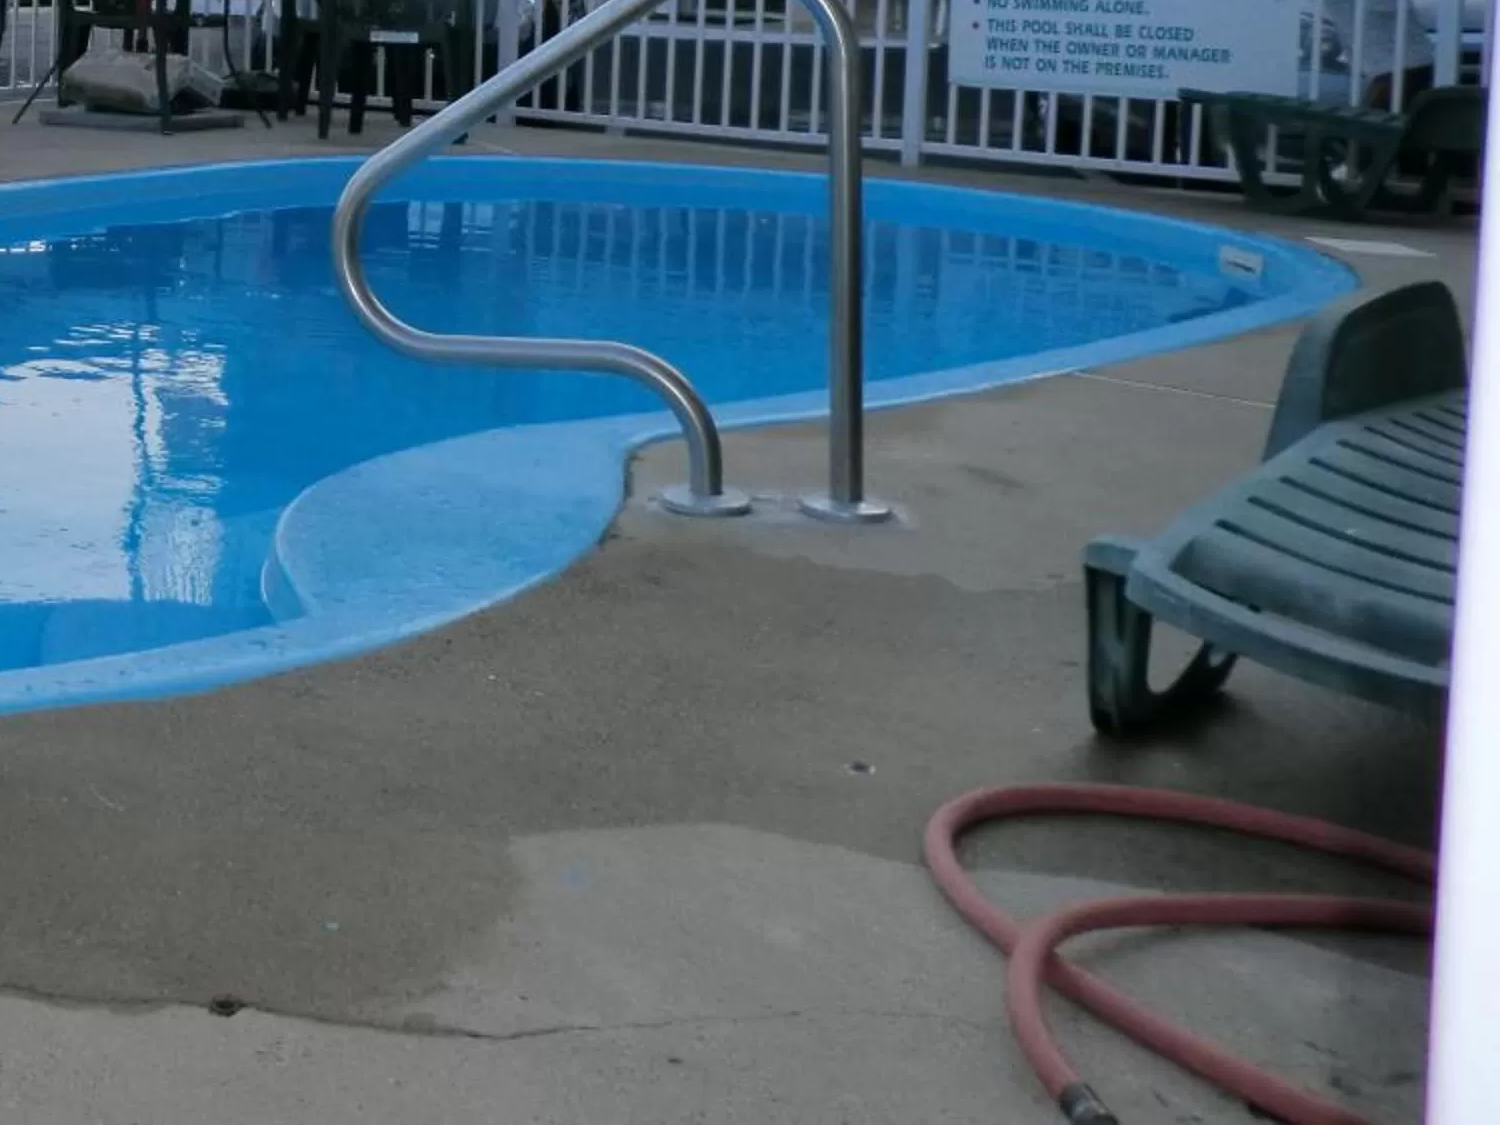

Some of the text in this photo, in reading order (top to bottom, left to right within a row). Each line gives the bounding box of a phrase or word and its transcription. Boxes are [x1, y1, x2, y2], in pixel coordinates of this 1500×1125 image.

[1095, 0, 1150, 15] ALONE.
[987, 18, 1195, 42] THIS POOL SHALL BE CLOSED
[987, 38, 1231, 64] WHEN THE OWNER OR MANAGER
[985, 55, 1170, 79] IS NOT ON THE PREMISES.
